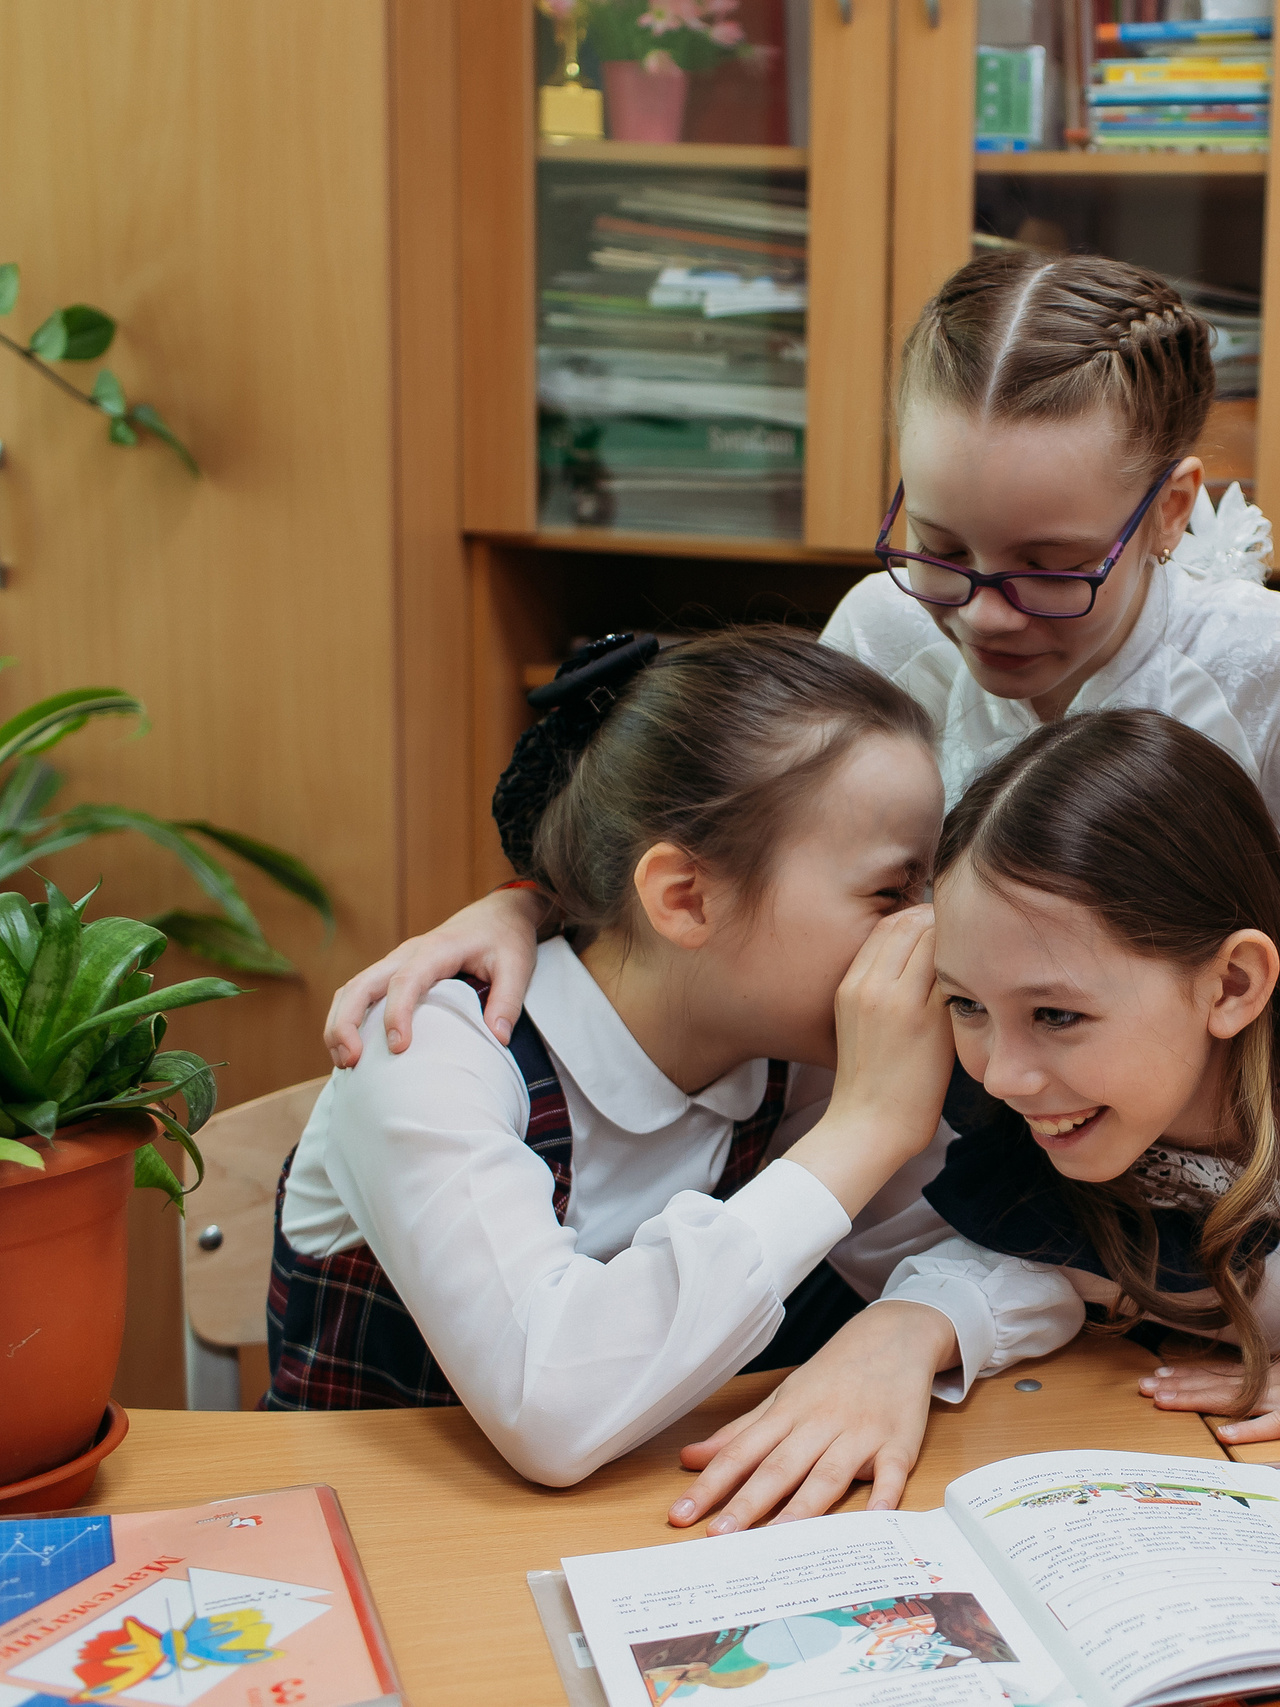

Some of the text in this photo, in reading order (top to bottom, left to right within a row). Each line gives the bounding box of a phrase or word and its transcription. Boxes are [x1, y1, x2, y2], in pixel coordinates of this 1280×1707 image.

[783, 1571, 846, 1585] окружность
[828, 1584, 889, 1598] симметрии
[775, 1597, 819, 1609] фигуры
[270, 1678, 306, 1705] 3
